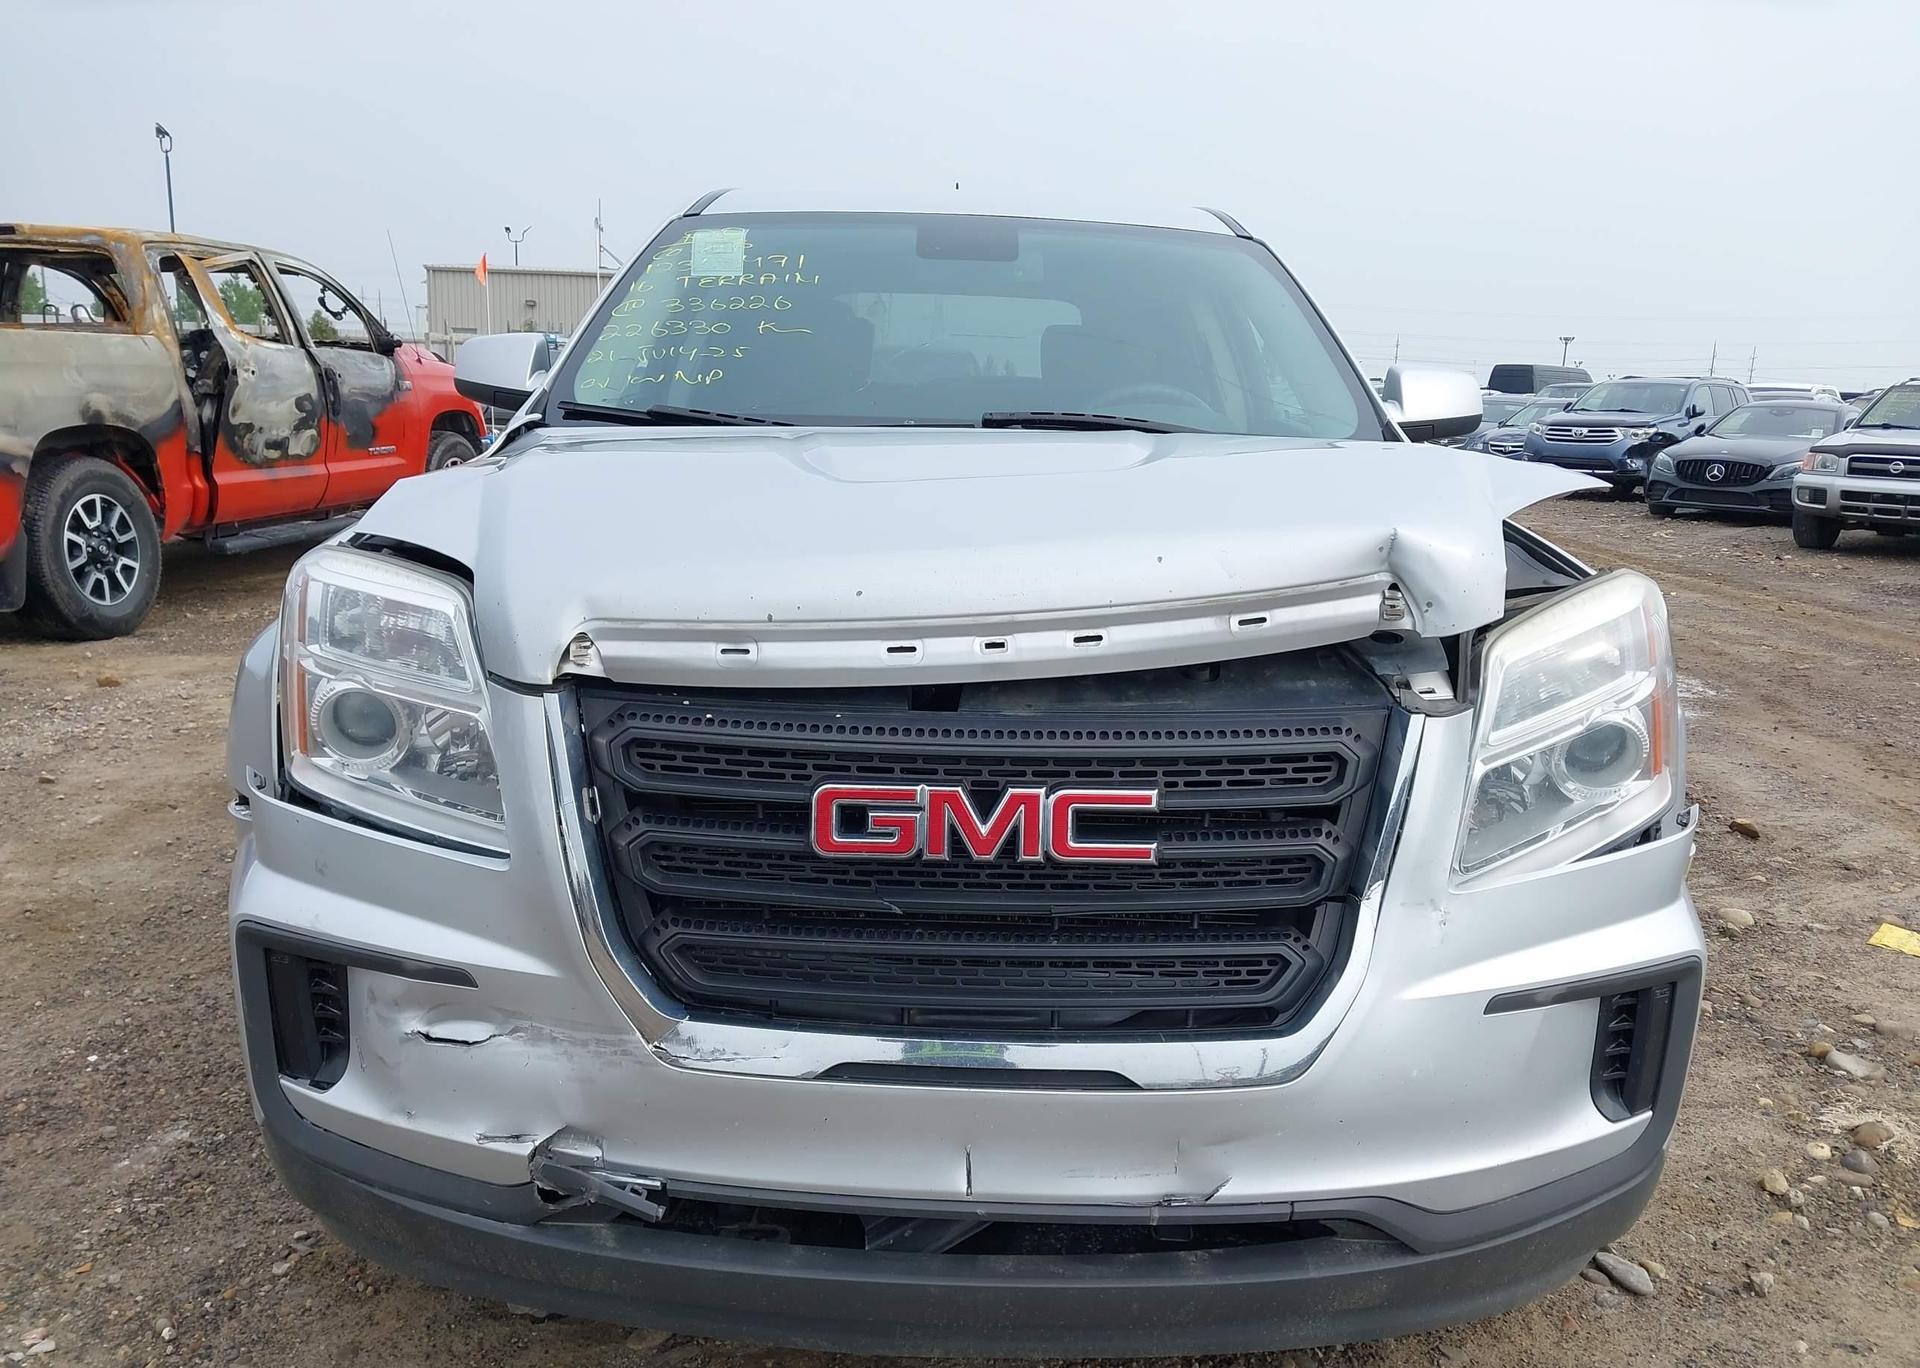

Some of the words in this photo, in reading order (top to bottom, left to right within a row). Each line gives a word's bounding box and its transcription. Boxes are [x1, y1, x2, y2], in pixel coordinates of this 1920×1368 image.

[675, 271, 820, 288] TERRAIN
[661, 294, 793, 314] 336226
[600, 320, 732, 341] 226330
[811, 783, 1159, 866] GMC
